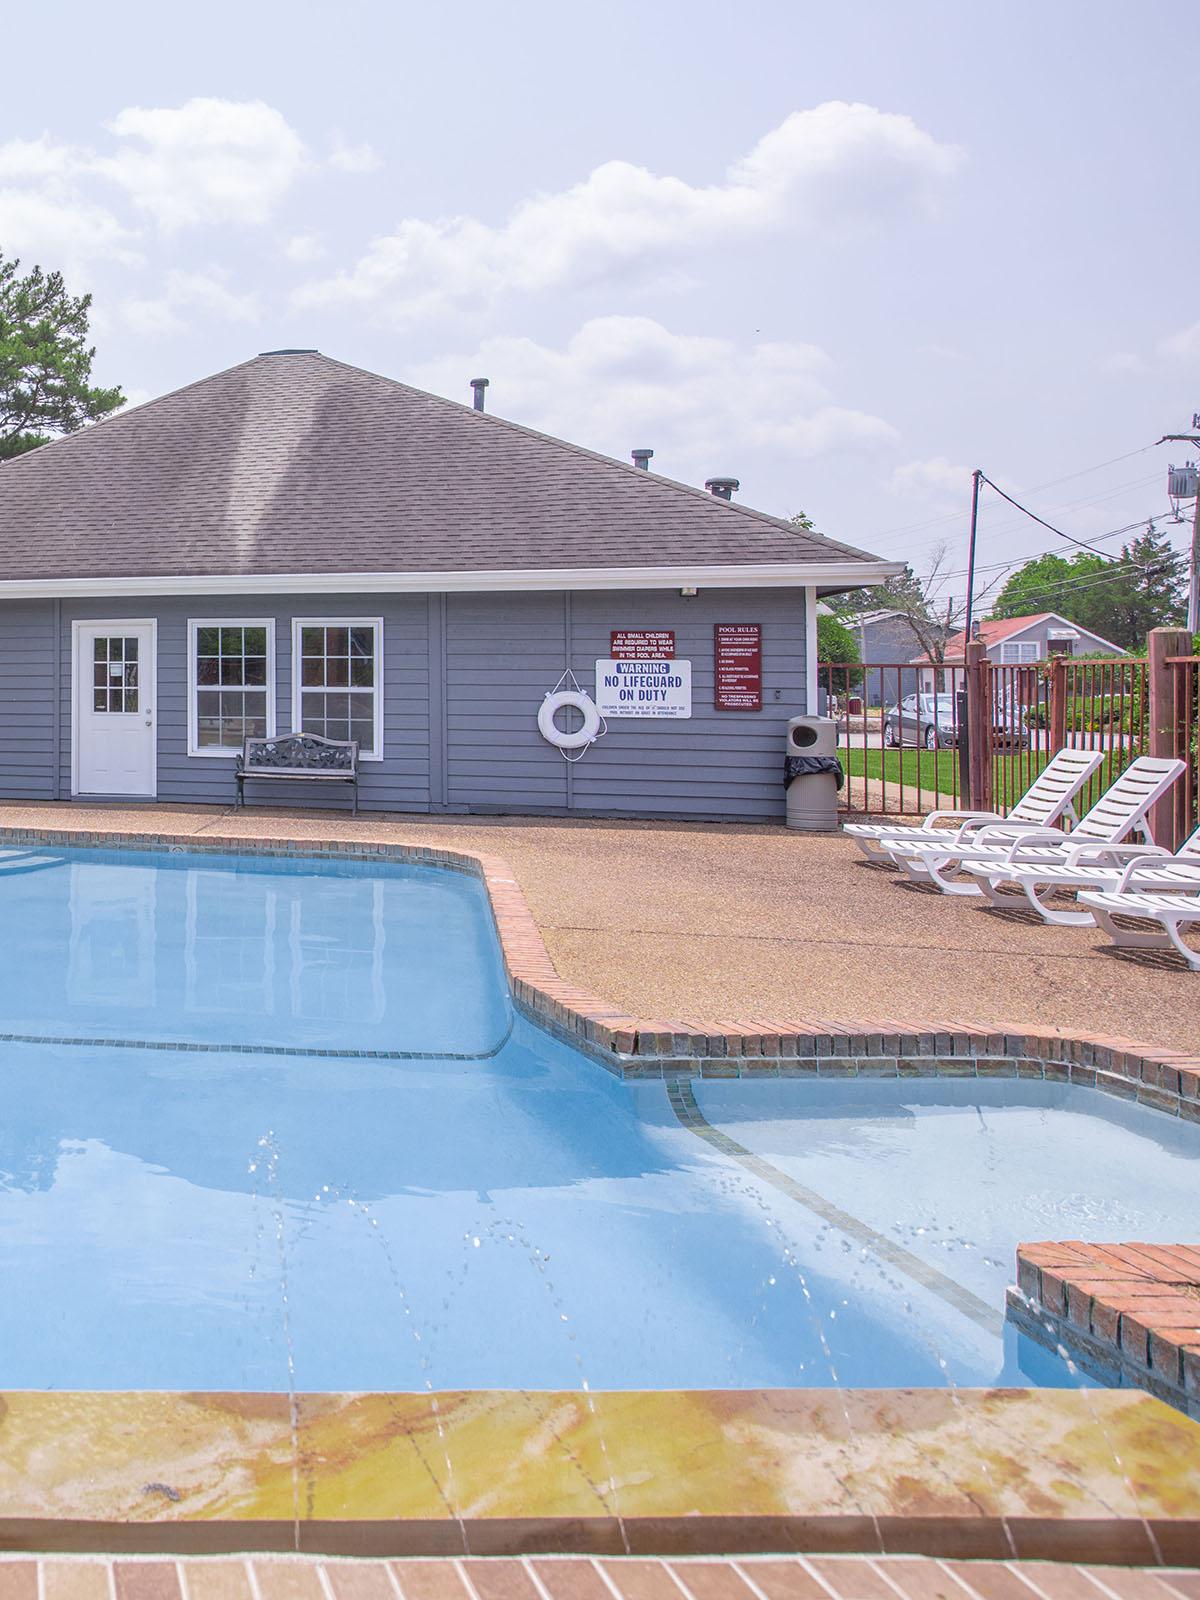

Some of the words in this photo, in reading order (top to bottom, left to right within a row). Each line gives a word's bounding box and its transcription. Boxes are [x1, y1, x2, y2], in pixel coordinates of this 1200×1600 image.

[620, 663, 667, 673] WARNING
[604, 675, 619, 687] NO
[624, 676, 682, 687] LIFEGUARD
[619, 689, 633, 701] ON
[639, 690, 667, 701] DUTY
